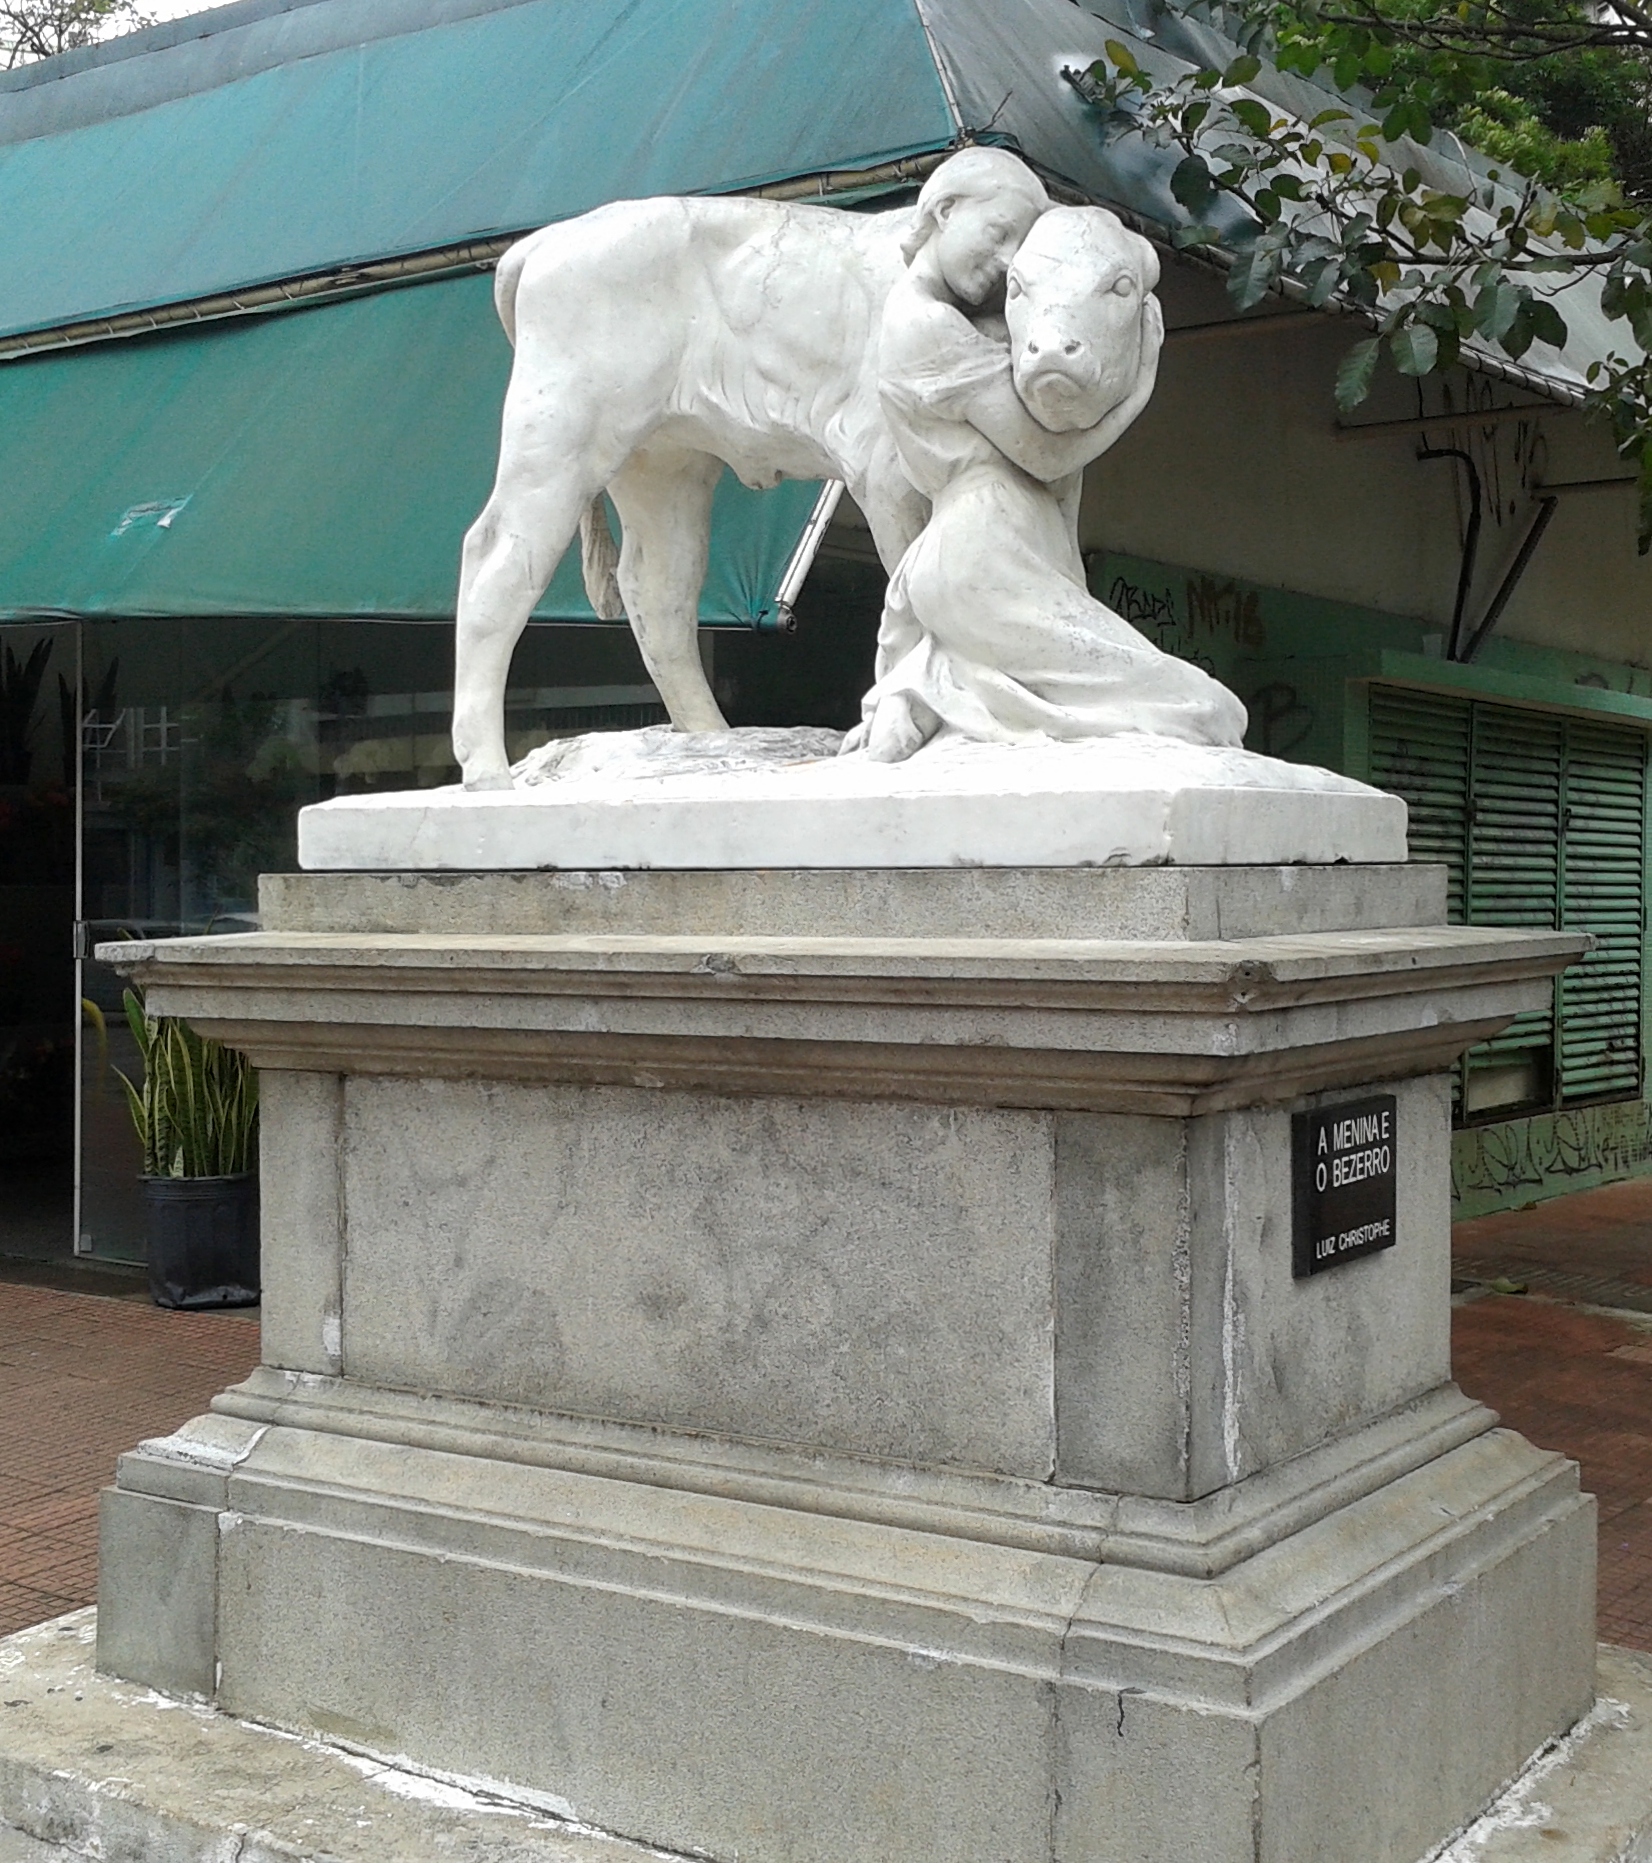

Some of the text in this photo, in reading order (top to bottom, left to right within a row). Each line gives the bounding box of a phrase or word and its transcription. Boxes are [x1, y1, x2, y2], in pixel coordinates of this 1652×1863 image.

[1318, 1111, 1390, 1156] A MENINA E
[1316, 1145, 1390, 1192] O BEZERRO
[1316, 1219, 1390, 1259] LUIZ CHRISTOPHE
